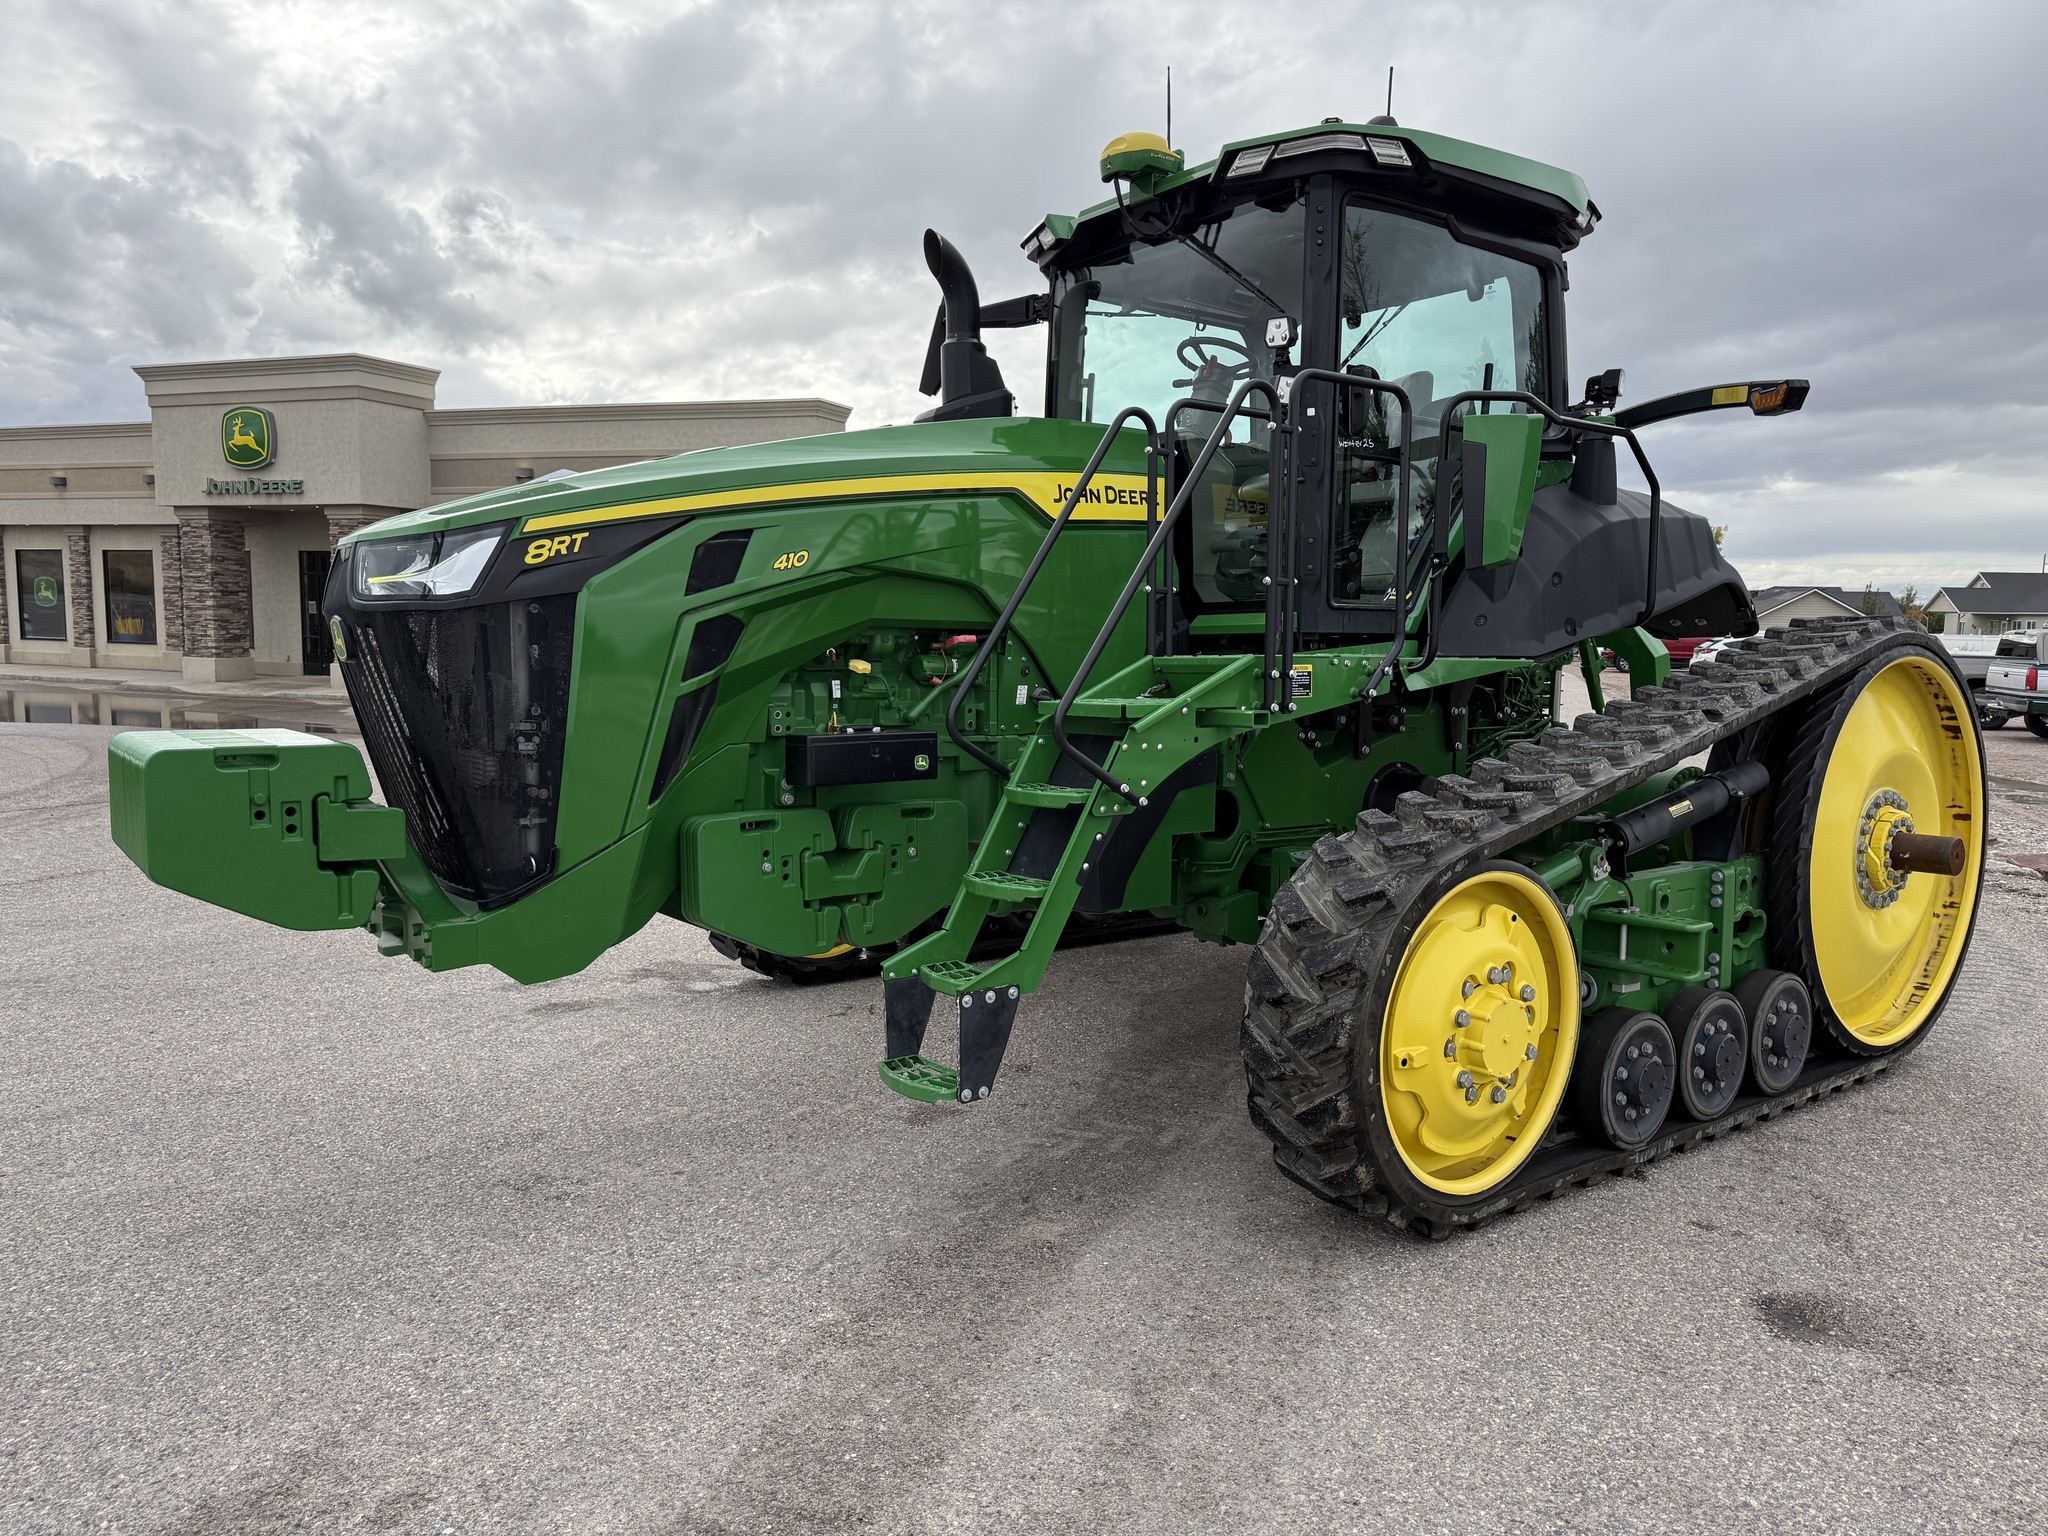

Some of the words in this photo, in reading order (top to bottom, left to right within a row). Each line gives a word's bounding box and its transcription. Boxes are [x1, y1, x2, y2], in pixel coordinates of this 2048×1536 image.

[202, 478, 246, 494] JOHN
[246, 477, 304, 495] DEERE
[1104, 485, 1160, 506] DEER
[524, 531, 590, 565] 8RT
[772, 549, 810, 571] 410
